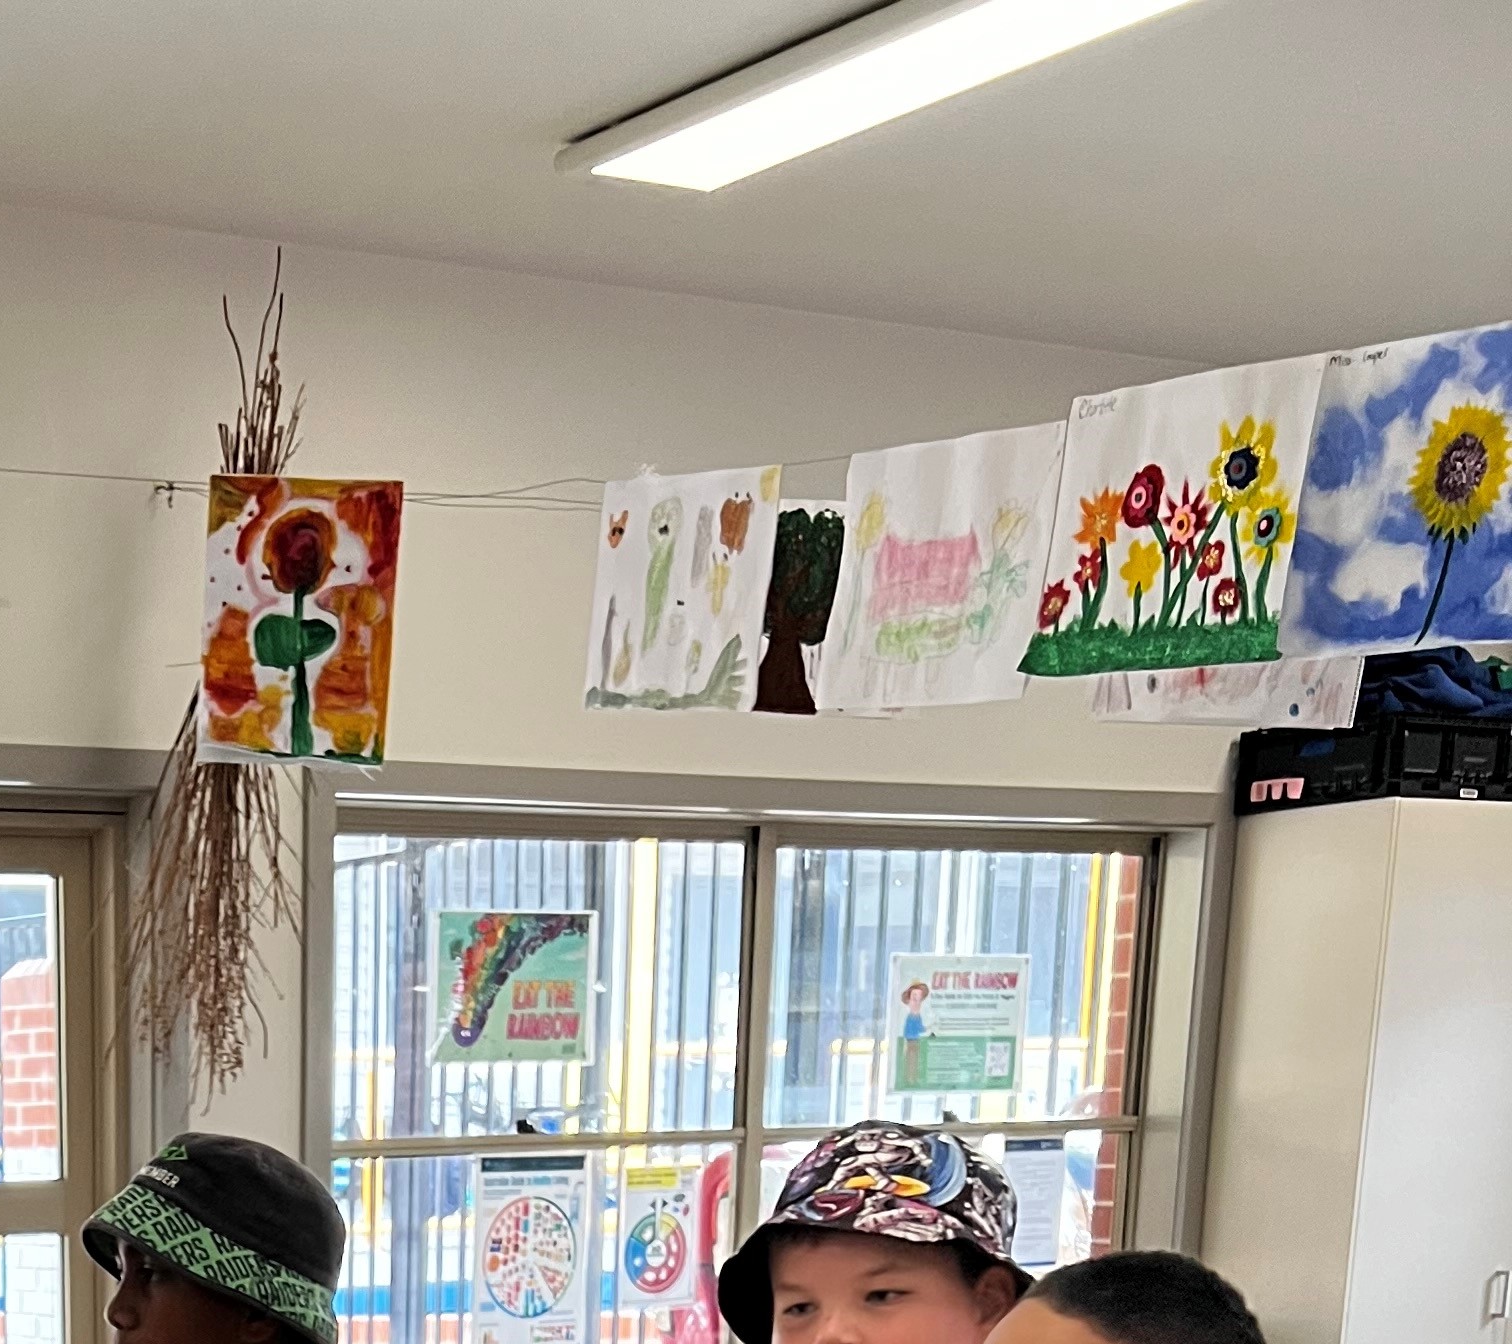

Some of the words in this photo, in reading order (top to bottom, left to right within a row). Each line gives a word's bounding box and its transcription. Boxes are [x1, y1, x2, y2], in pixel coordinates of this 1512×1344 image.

[512, 981, 539, 1010] EAT
[545, 981, 575, 1008] THE
[506, 1013, 581, 1040] RAINBOW
